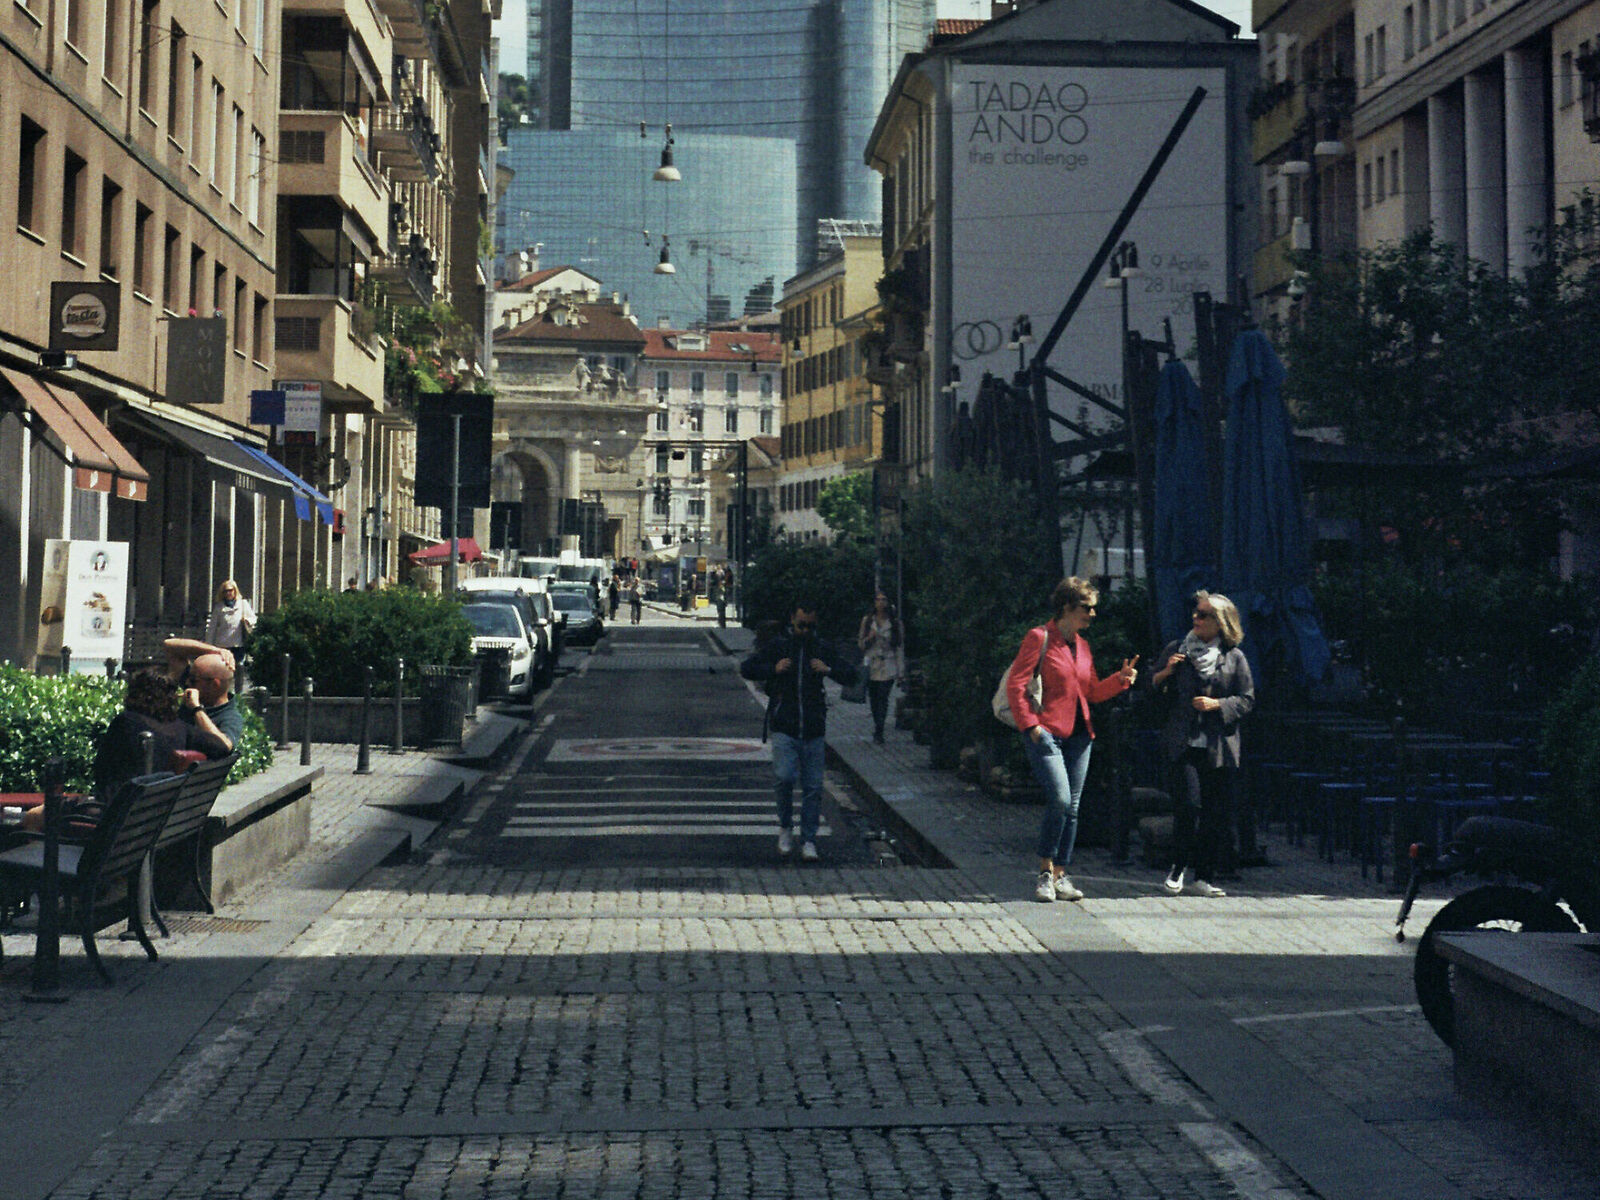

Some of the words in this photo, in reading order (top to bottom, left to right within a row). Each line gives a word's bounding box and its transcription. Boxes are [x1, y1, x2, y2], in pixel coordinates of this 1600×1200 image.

[968, 81, 1089, 112] TADAO
[968, 114, 1089, 144] ANDO
[968, 149, 994, 165] the
[1003, 149, 1089, 170] challenge
